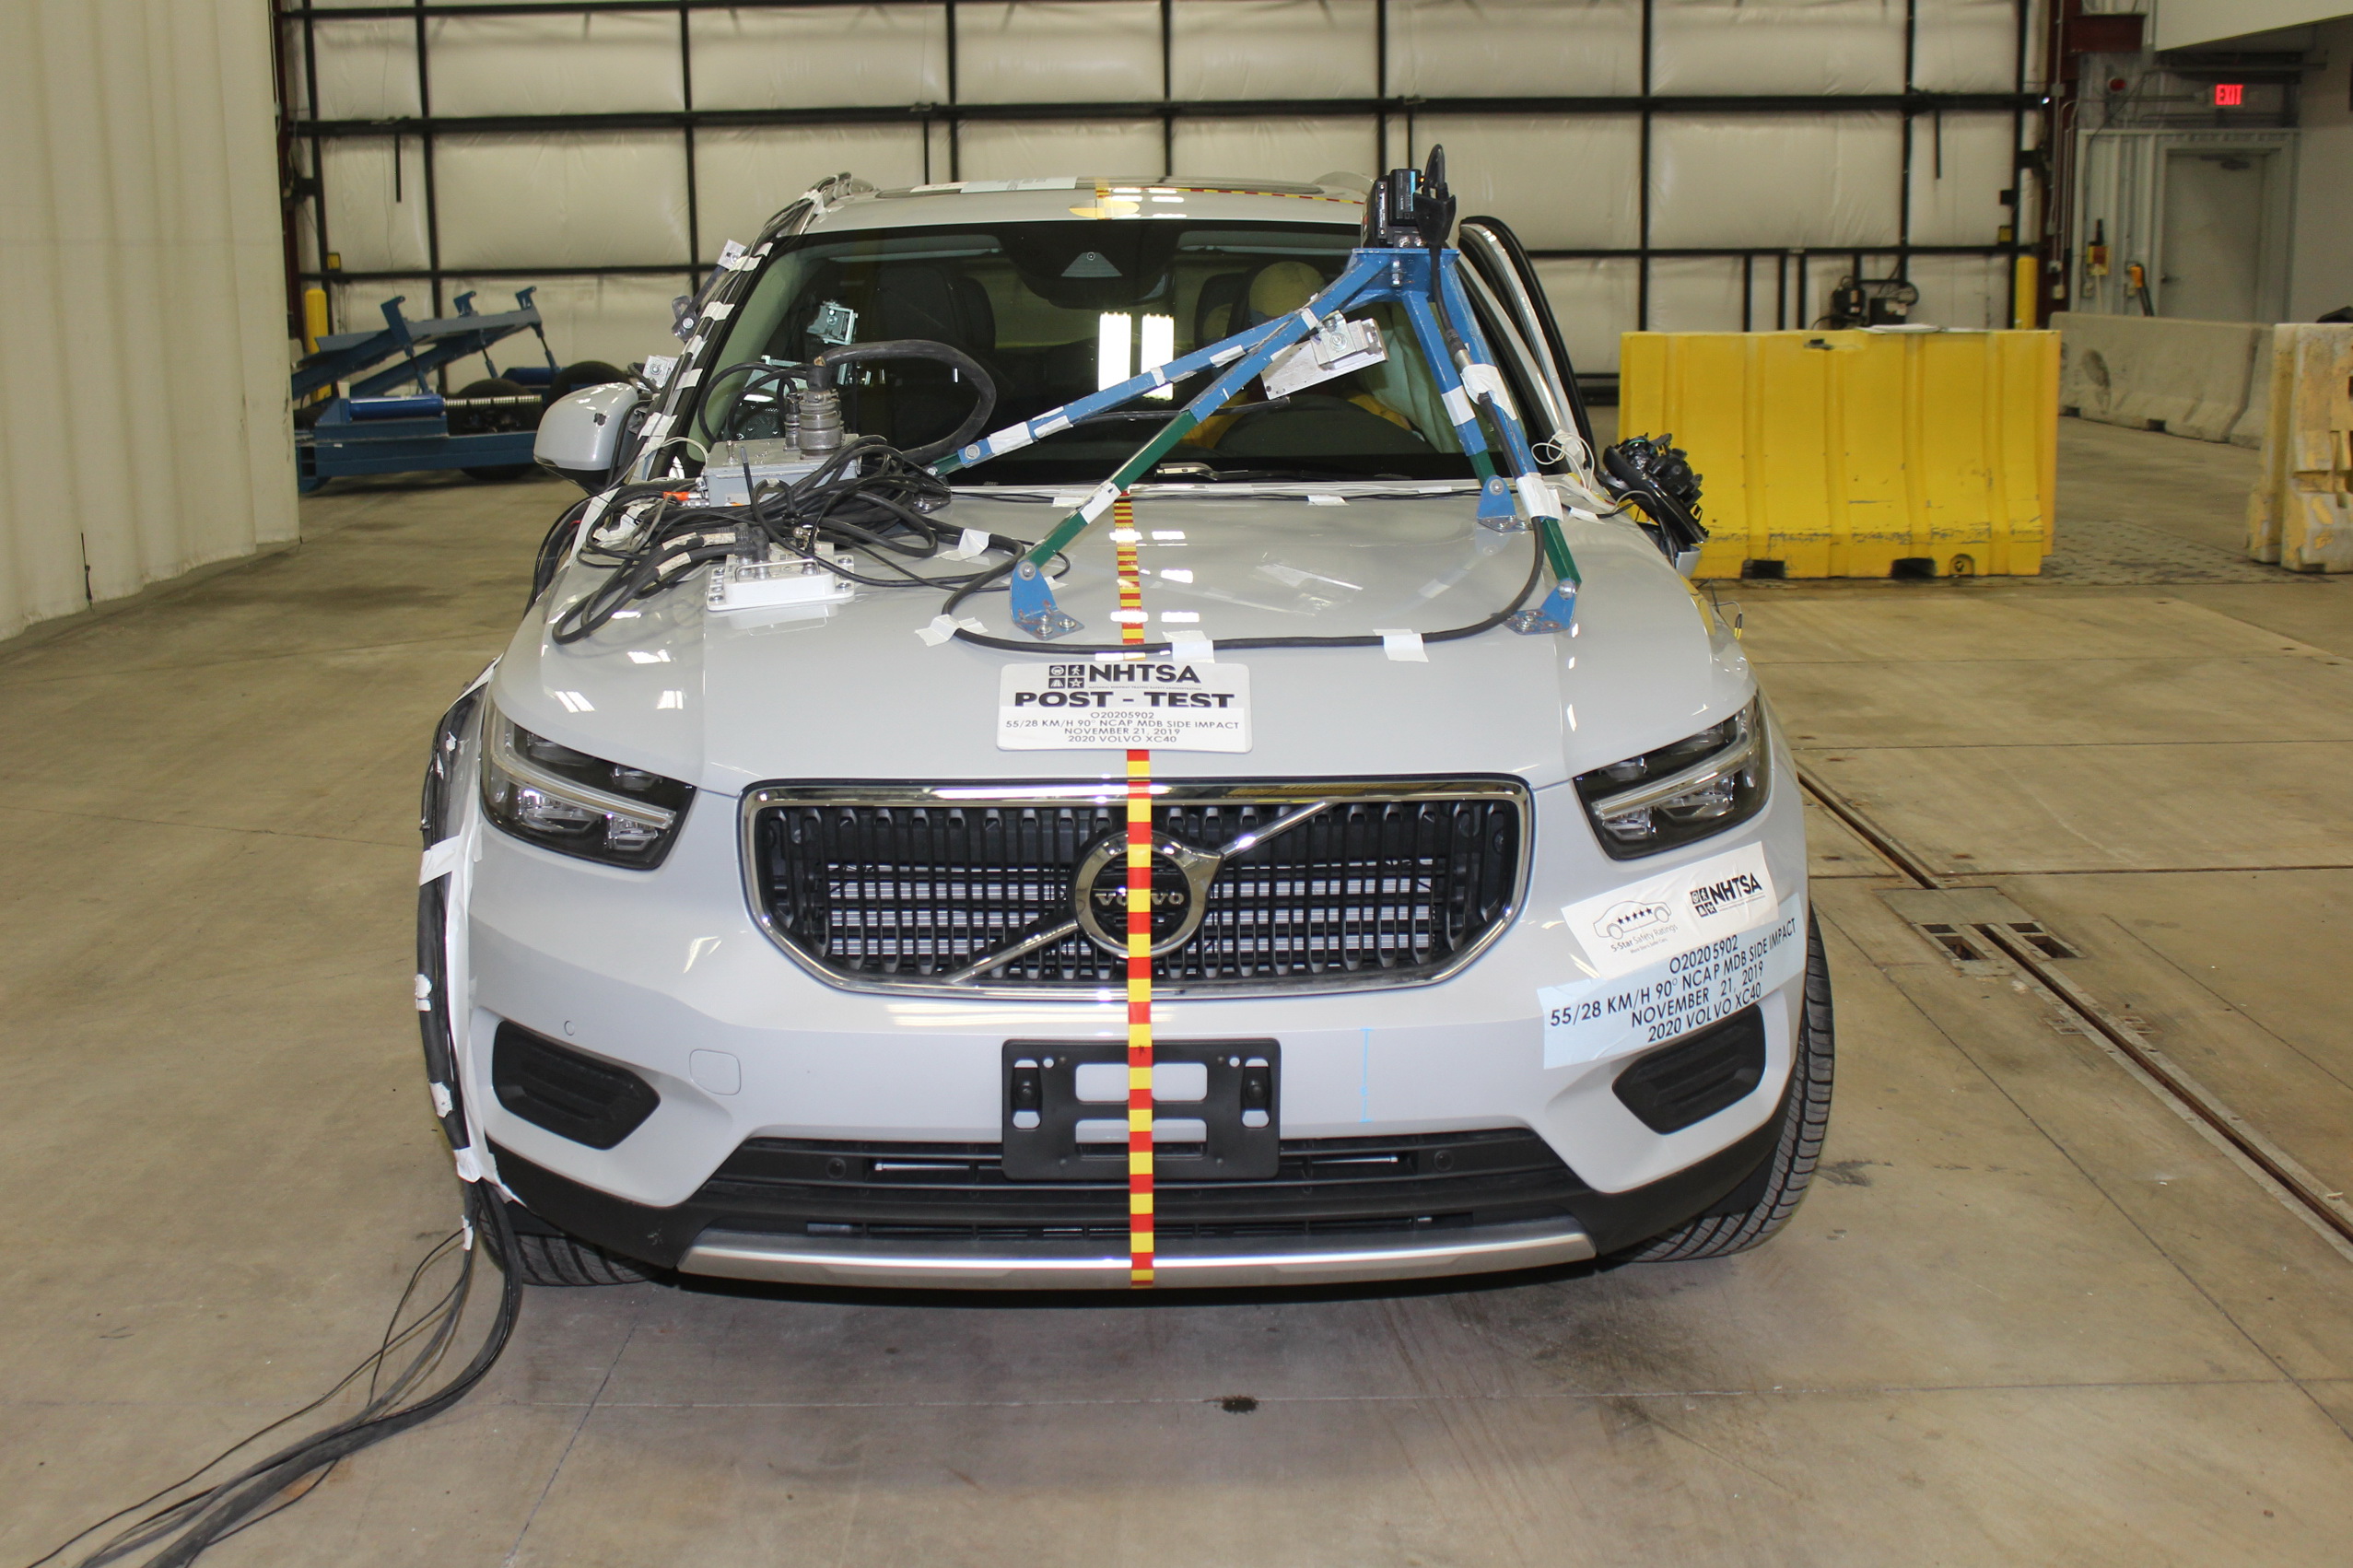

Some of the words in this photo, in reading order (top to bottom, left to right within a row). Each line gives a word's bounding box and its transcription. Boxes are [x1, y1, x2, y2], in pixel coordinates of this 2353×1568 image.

[2215, 84, 2244, 106] EXIT
[1089, 663, 1201, 684] NHTSA
[1014, 691, 1114, 708] POST
[1144, 692, 1235, 708] TEST
[1005, 720, 1038, 728] 55/28
[1042, 719, 1074, 728] KM/H
[1194, 720, 1239, 730] IMPACT
[1146, 735, 1177, 743] XC40
[1095, 893, 1185, 906] VOVO
[1708, 872, 1762, 905] NHTSA
[1610, 940, 1633, 953] 5-Star
[1633, 931, 1655, 943] Safety
[1653, 924, 1679, 937] Ratings
[1551, 1000, 1601, 1027] 55/28
[1608, 987, 1650, 1014] KM/H
[1682, 969, 1719, 997] NCAP
[1723, 953, 1747, 977] MDB
[1749, 940, 1768, 963] SIDE
[1769, 918, 1797, 954] IMPACT
[1632, 988, 1709, 1028] NOVEMBER
[1720, 977, 1737, 997] 21,
[1742, 961, 1763, 986] 2019
[1647, 1020, 1681, 1044] 2020
[1687, 998, 1732, 1029] VOLVO
[1735, 983, 1762, 1010] XC40
